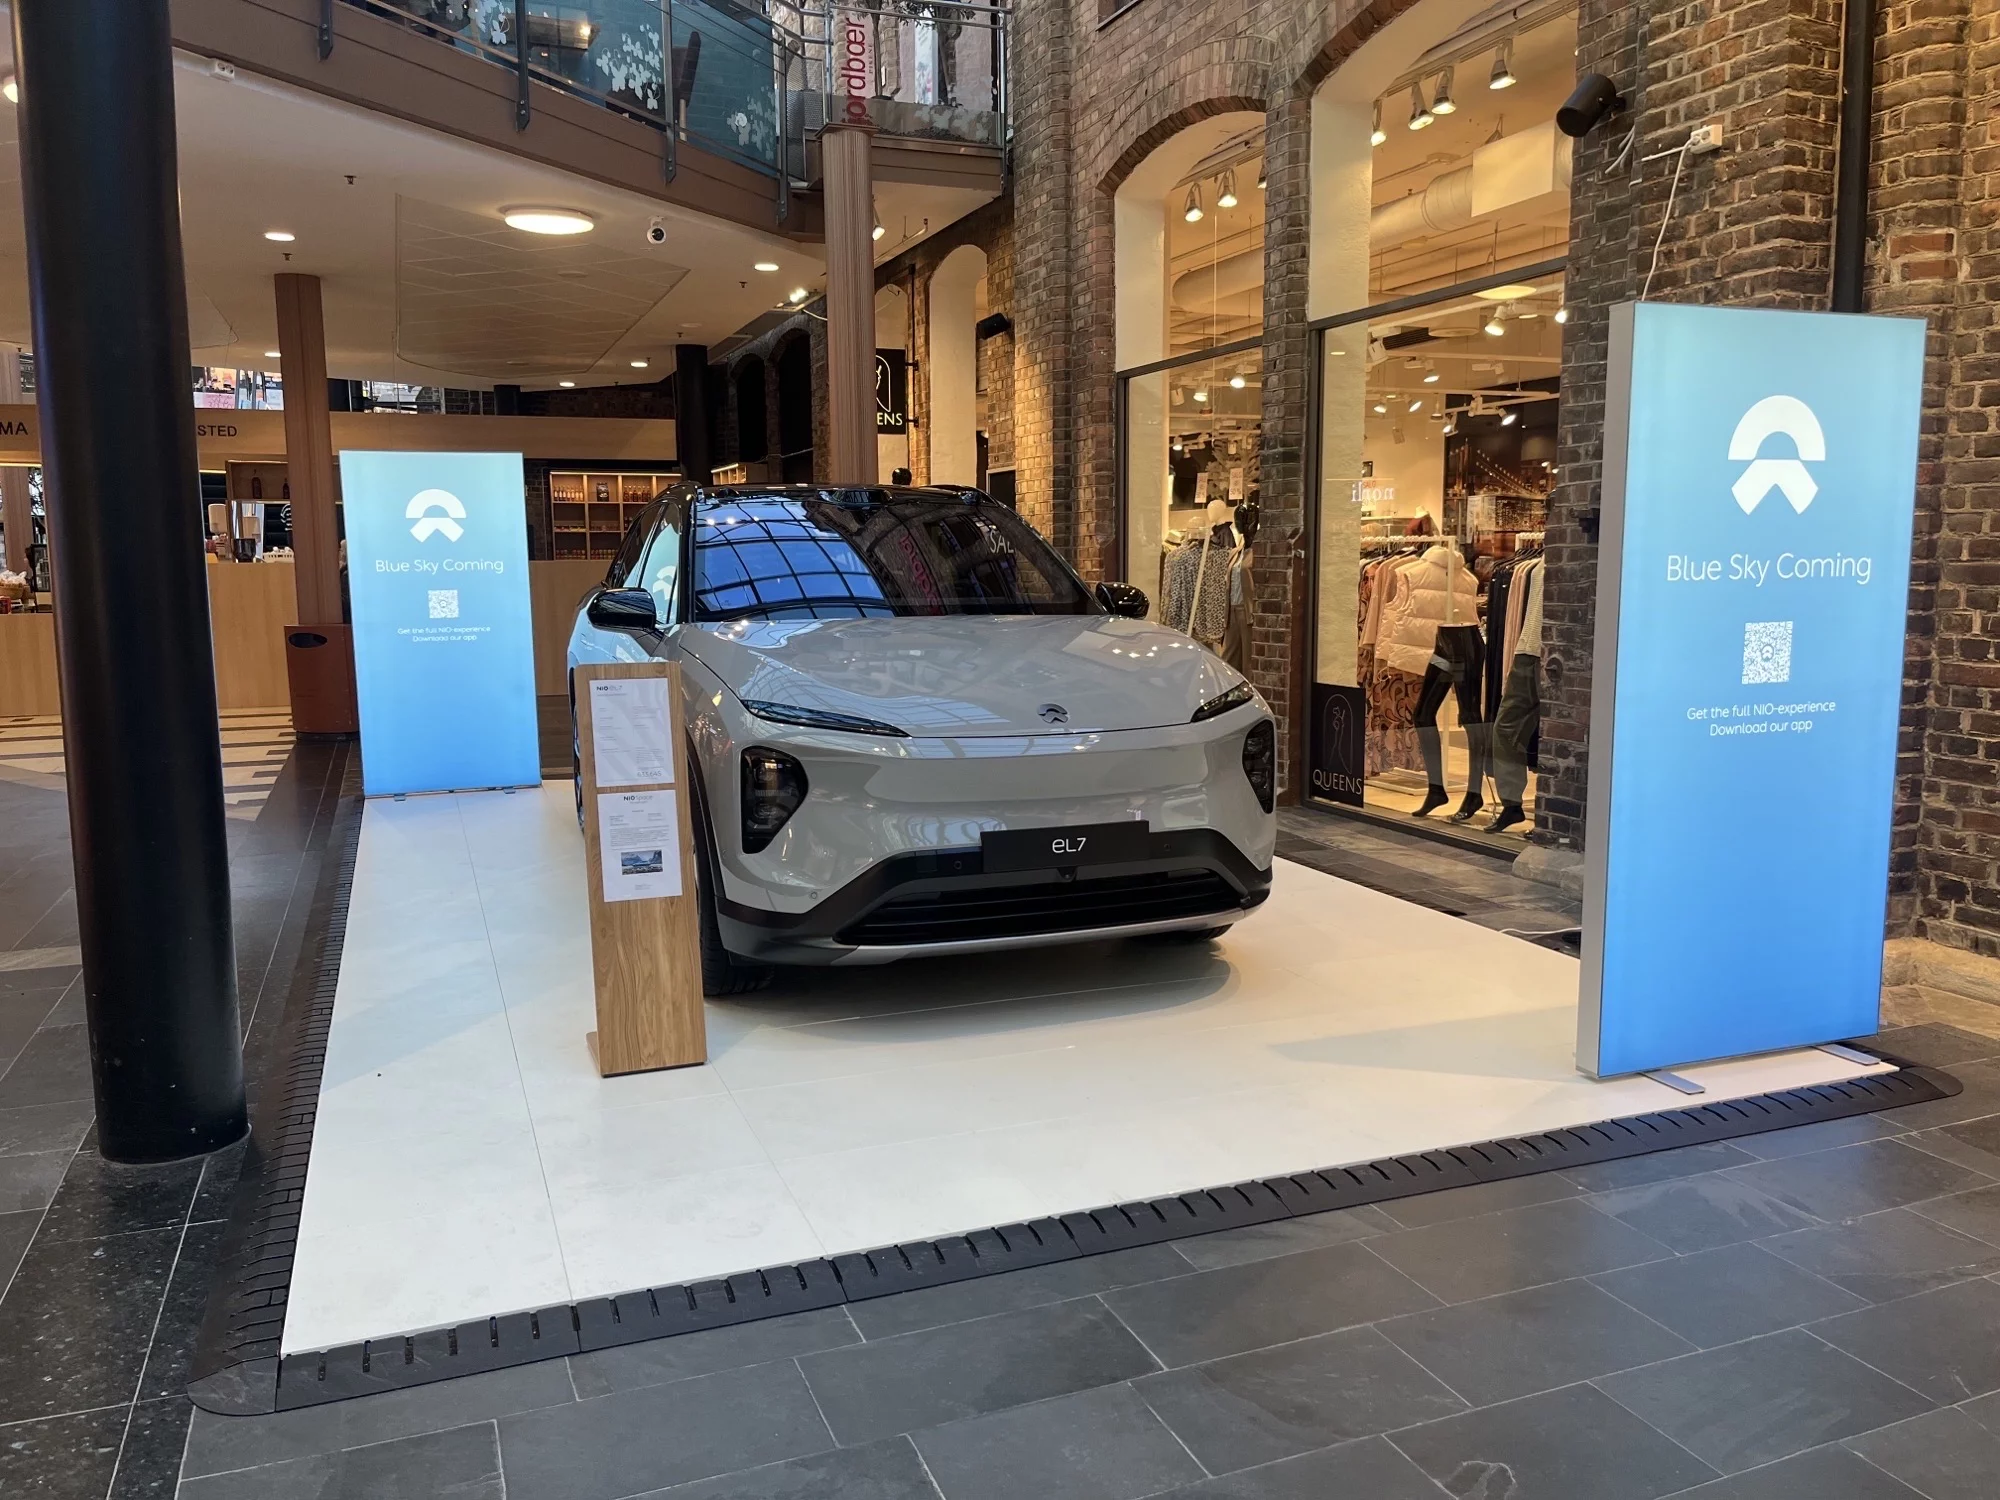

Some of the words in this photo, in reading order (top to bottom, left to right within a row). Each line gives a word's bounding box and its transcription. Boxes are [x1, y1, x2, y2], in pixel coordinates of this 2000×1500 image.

[197, 424, 238, 437] STED
[990, 529, 1016, 554] SAL
[376, 560, 410, 572] Blue
[414, 559, 438, 574] Sky
[443, 558, 504, 574] Coming
[1666, 554, 1722, 582] Blue
[1728, 554, 1770, 587] Sky
[1776, 552, 1872, 586] Coming
[1686, 706, 1708, 720] Get
[1710, 706, 1730, 719] the
[1732, 704, 1750, 718] full
[1753, 700, 1836, 716] NIO-experience
[1710, 722, 1767, 736] Download
[1769, 721, 1788, 732] our
[1790, 720, 1813, 733] app
[1312, 769, 1362, 795] QUEENS
